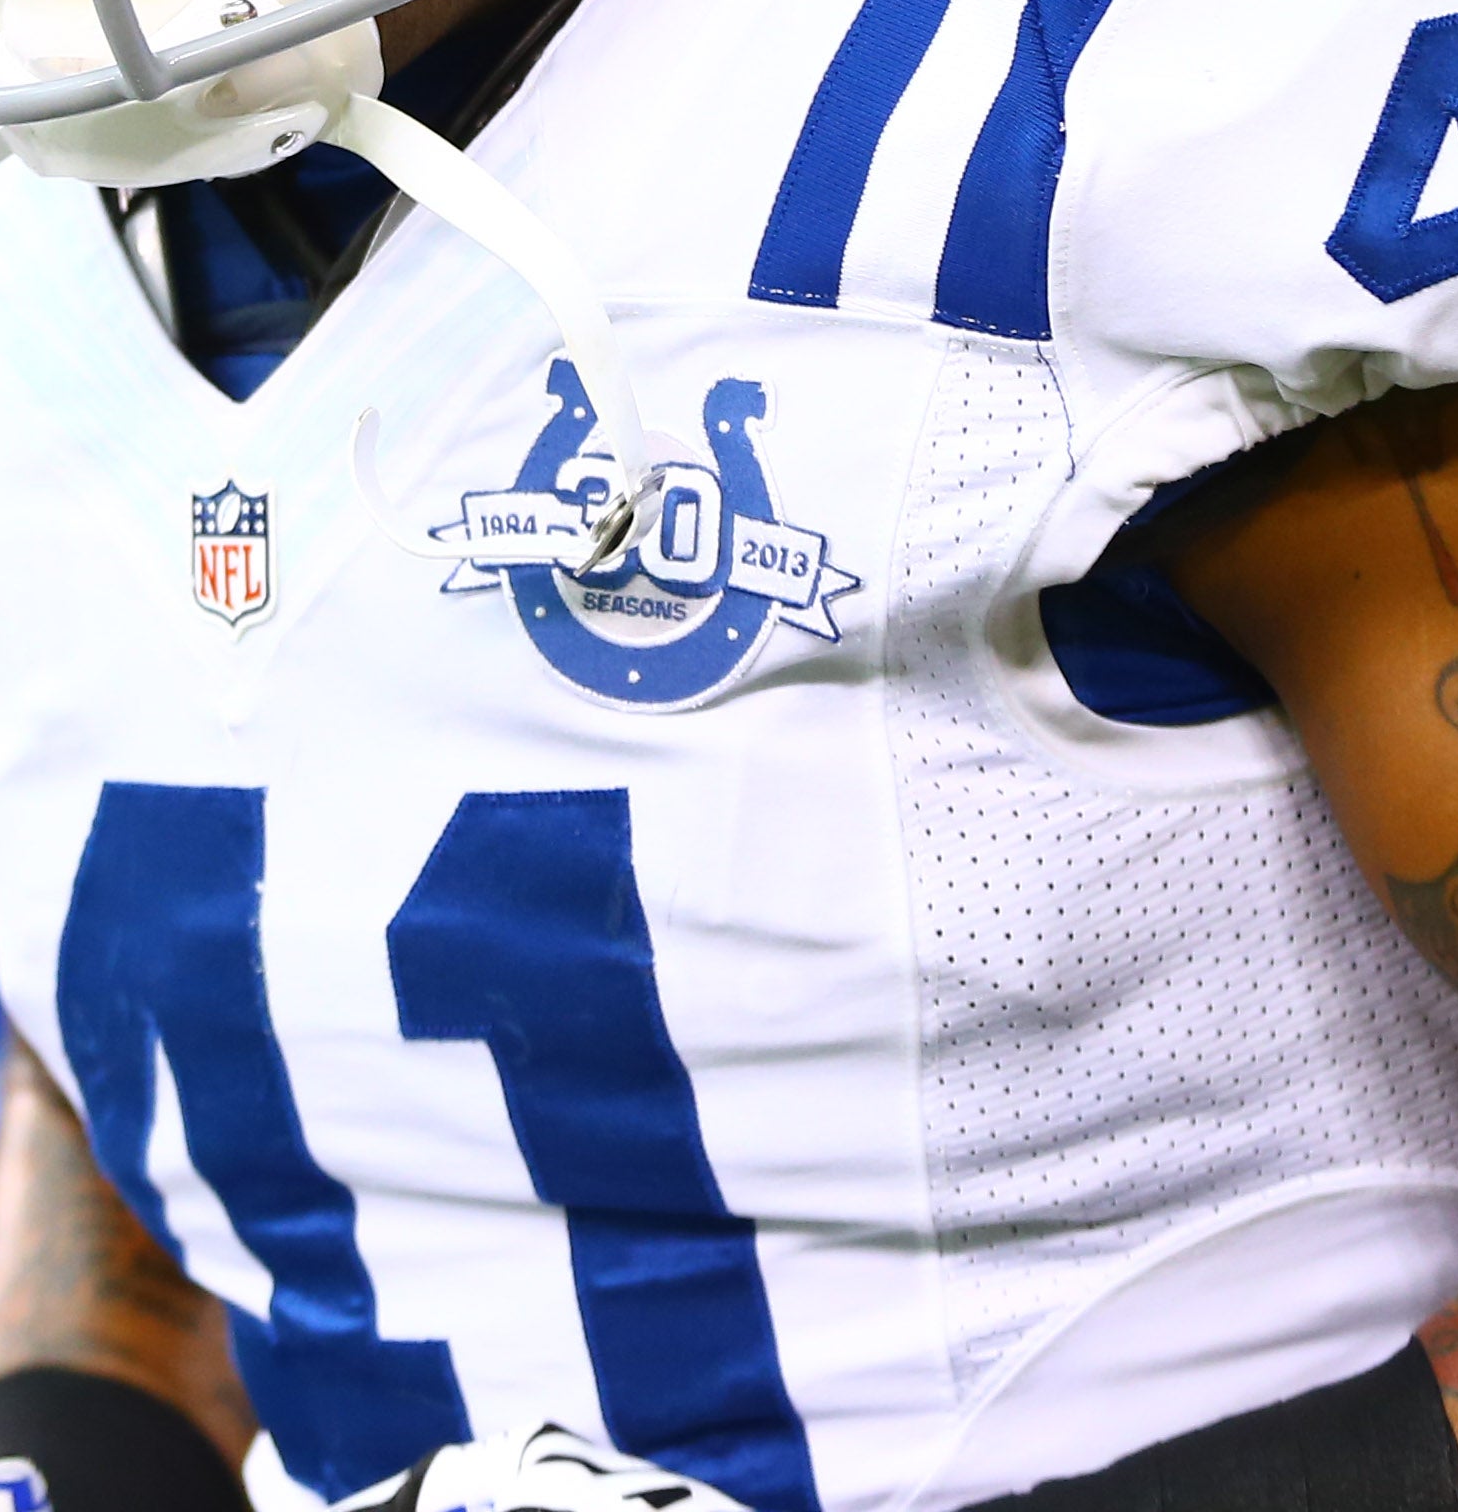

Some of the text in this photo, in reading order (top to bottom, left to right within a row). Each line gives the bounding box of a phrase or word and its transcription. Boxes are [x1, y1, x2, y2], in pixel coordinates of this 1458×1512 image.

[199, 544, 262, 610] NFL
[741, 541, 810, 579] 2013
[583, 590, 688, 622] SEASONS
[56, 781, 824, 1511] 41
